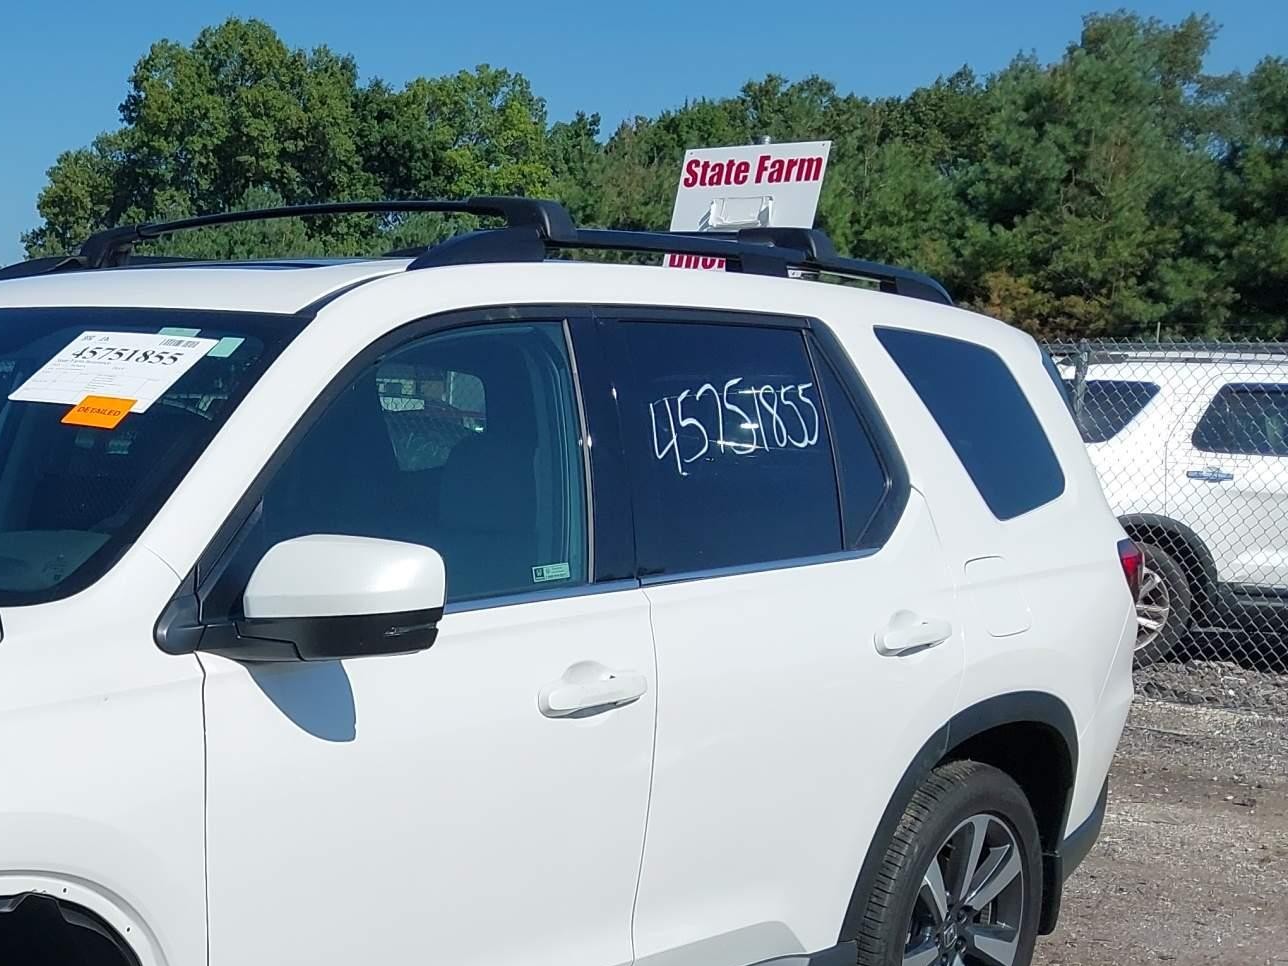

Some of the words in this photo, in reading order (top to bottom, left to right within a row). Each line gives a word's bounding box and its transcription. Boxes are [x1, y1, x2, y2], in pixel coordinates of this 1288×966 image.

[683, 158, 750, 188] State
[754, 155, 823, 184] Farm
[71, 346, 184, 366] 45751855
[77, 406, 121, 417] DETAILED
[650, 377, 819, 476] 45751855
